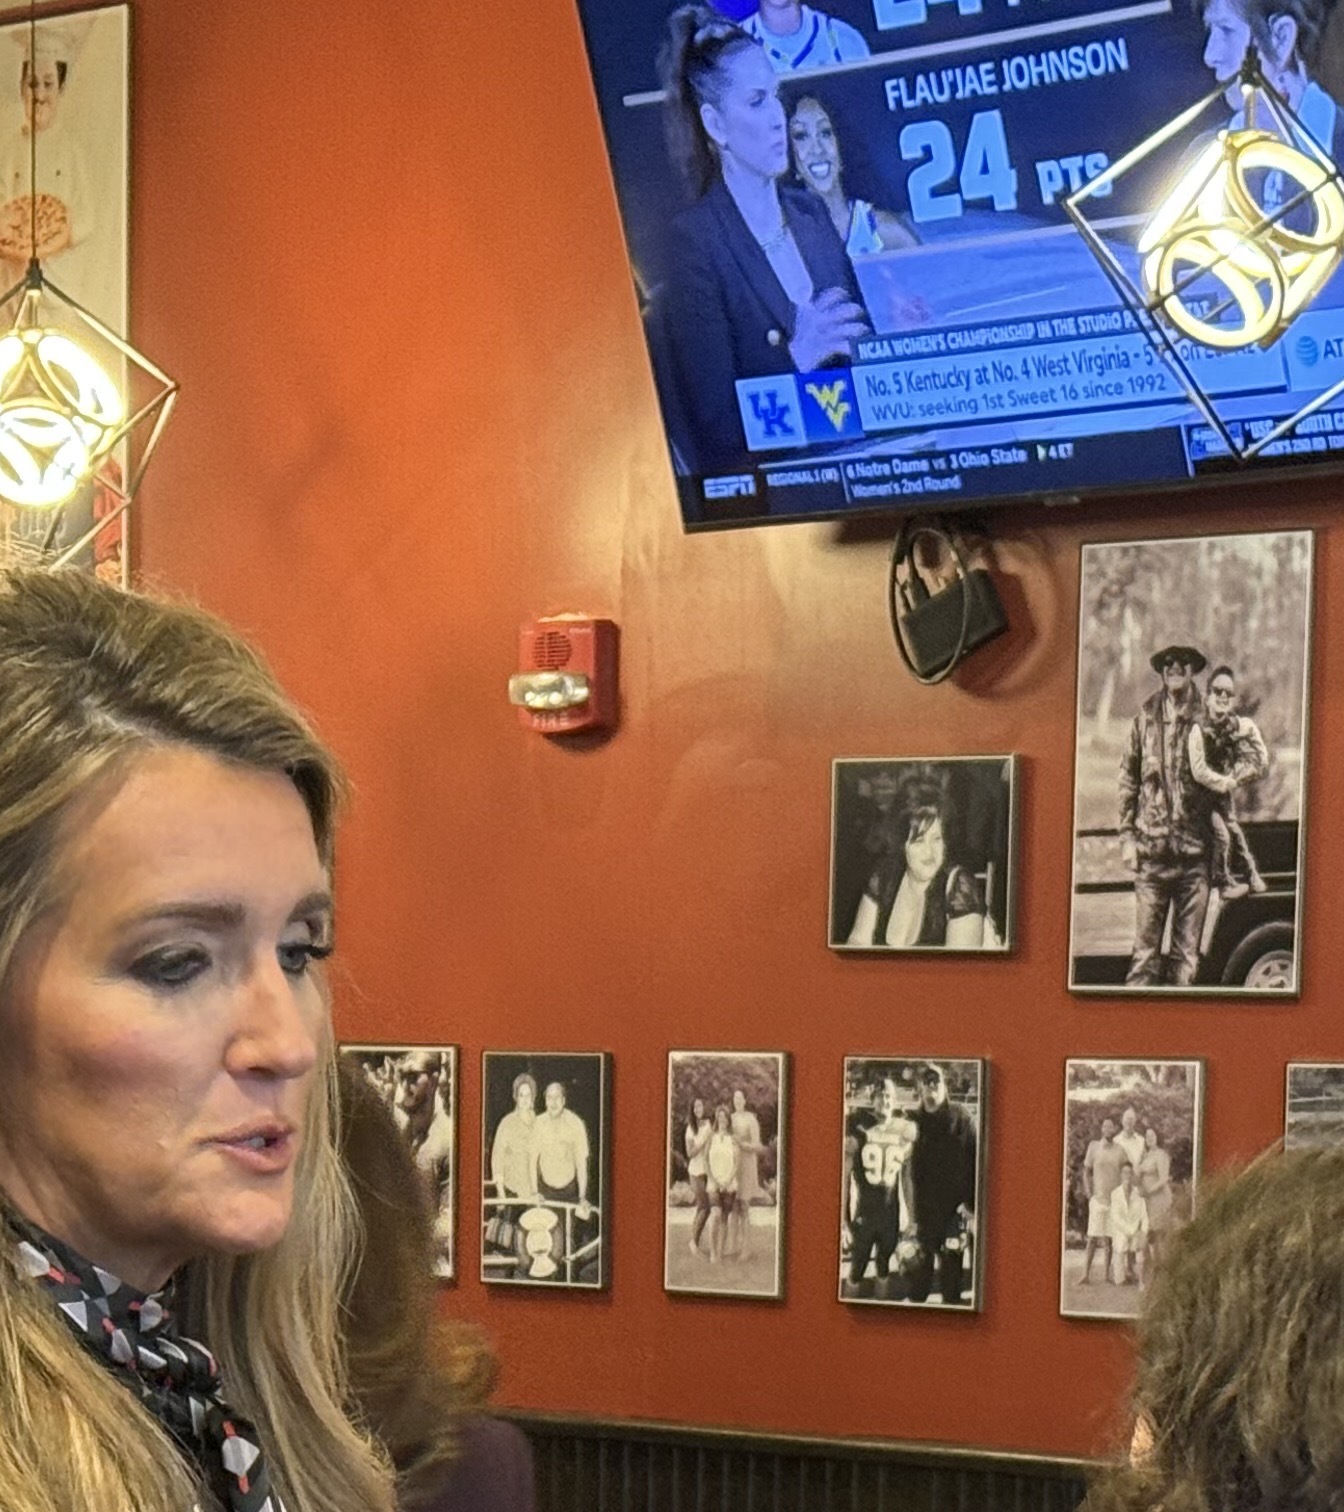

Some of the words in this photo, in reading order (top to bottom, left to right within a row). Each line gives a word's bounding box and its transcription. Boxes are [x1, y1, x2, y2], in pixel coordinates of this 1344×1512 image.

[884, 61, 999, 111] FLAU'JAE
[1002, 38, 1129, 90] JOHNSON
[899, 109, 1018, 223] 24
[1036, 152, 1113, 205] PTS
[858, 342, 892, 360] NCAA
[892, 333, 946, 356] WOMEN'S
[947, 323, 1035, 348] CHAMPIONSHIP
[1037, 320, 1052, 338] IN
[1052, 316, 1076, 336] THE
[1077, 312, 1122, 333] STUDIO
[865, 374, 891, 398] No.
[892, 371, 904, 395] 5
[905, 363, 971, 394] Kentucky
[974, 365, 989, 386] at
[991, 360, 1019, 383] No.
[1020, 357, 1031, 380] 4
[1031, 355, 1071, 378] West
[1071, 345, 1130, 376] Virginia
[747, 389, 796, 438] UK
[871, 400, 916, 423] WVU:
[918, 394, 978, 416] seeking
[982, 392, 1005, 411] 1st
[1007, 387, 1057, 408] Sweet
[1059, 383, 1078, 401] 16
[1082, 380, 1123, 400] since
[1126, 373, 1167, 394] 1992
[703, 474, 756, 498] ESPN
[851, 480, 901, 498] Women's
[902, 477, 923, 494] 2nd
[924, 474, 962, 491] Round
[856, 461, 891, 478] Notre
[892, 457, 930, 474] Dame
[932, 457, 947, 471] vs
[958, 450, 989, 467] Ohio
[991, 447, 1028, 465] State
